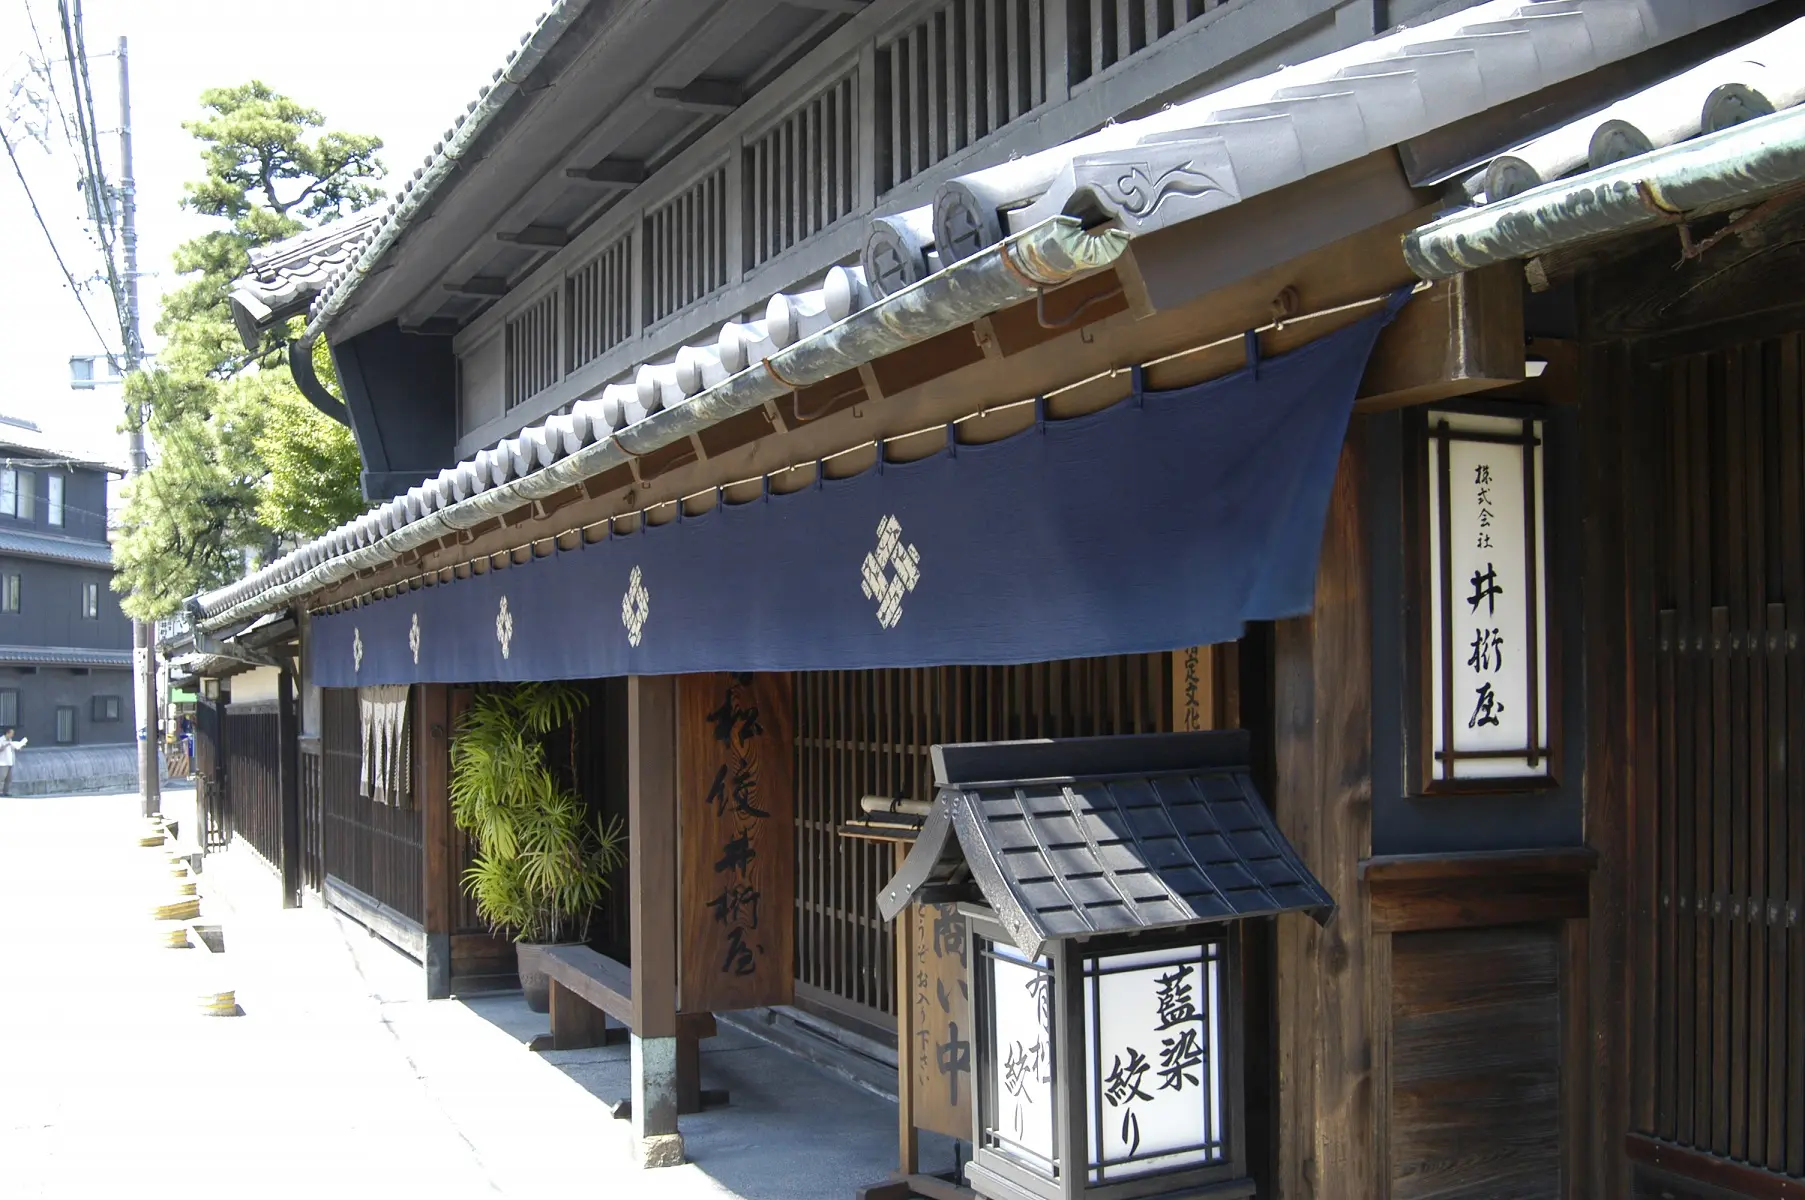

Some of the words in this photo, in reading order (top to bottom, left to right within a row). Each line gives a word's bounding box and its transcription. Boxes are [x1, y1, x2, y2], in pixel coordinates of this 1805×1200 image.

[1466, 562, 1504, 728] 井桁屋
[1153, 964, 1205, 1091] 藍染
[1104, 1047, 1155, 1158] 絞り
